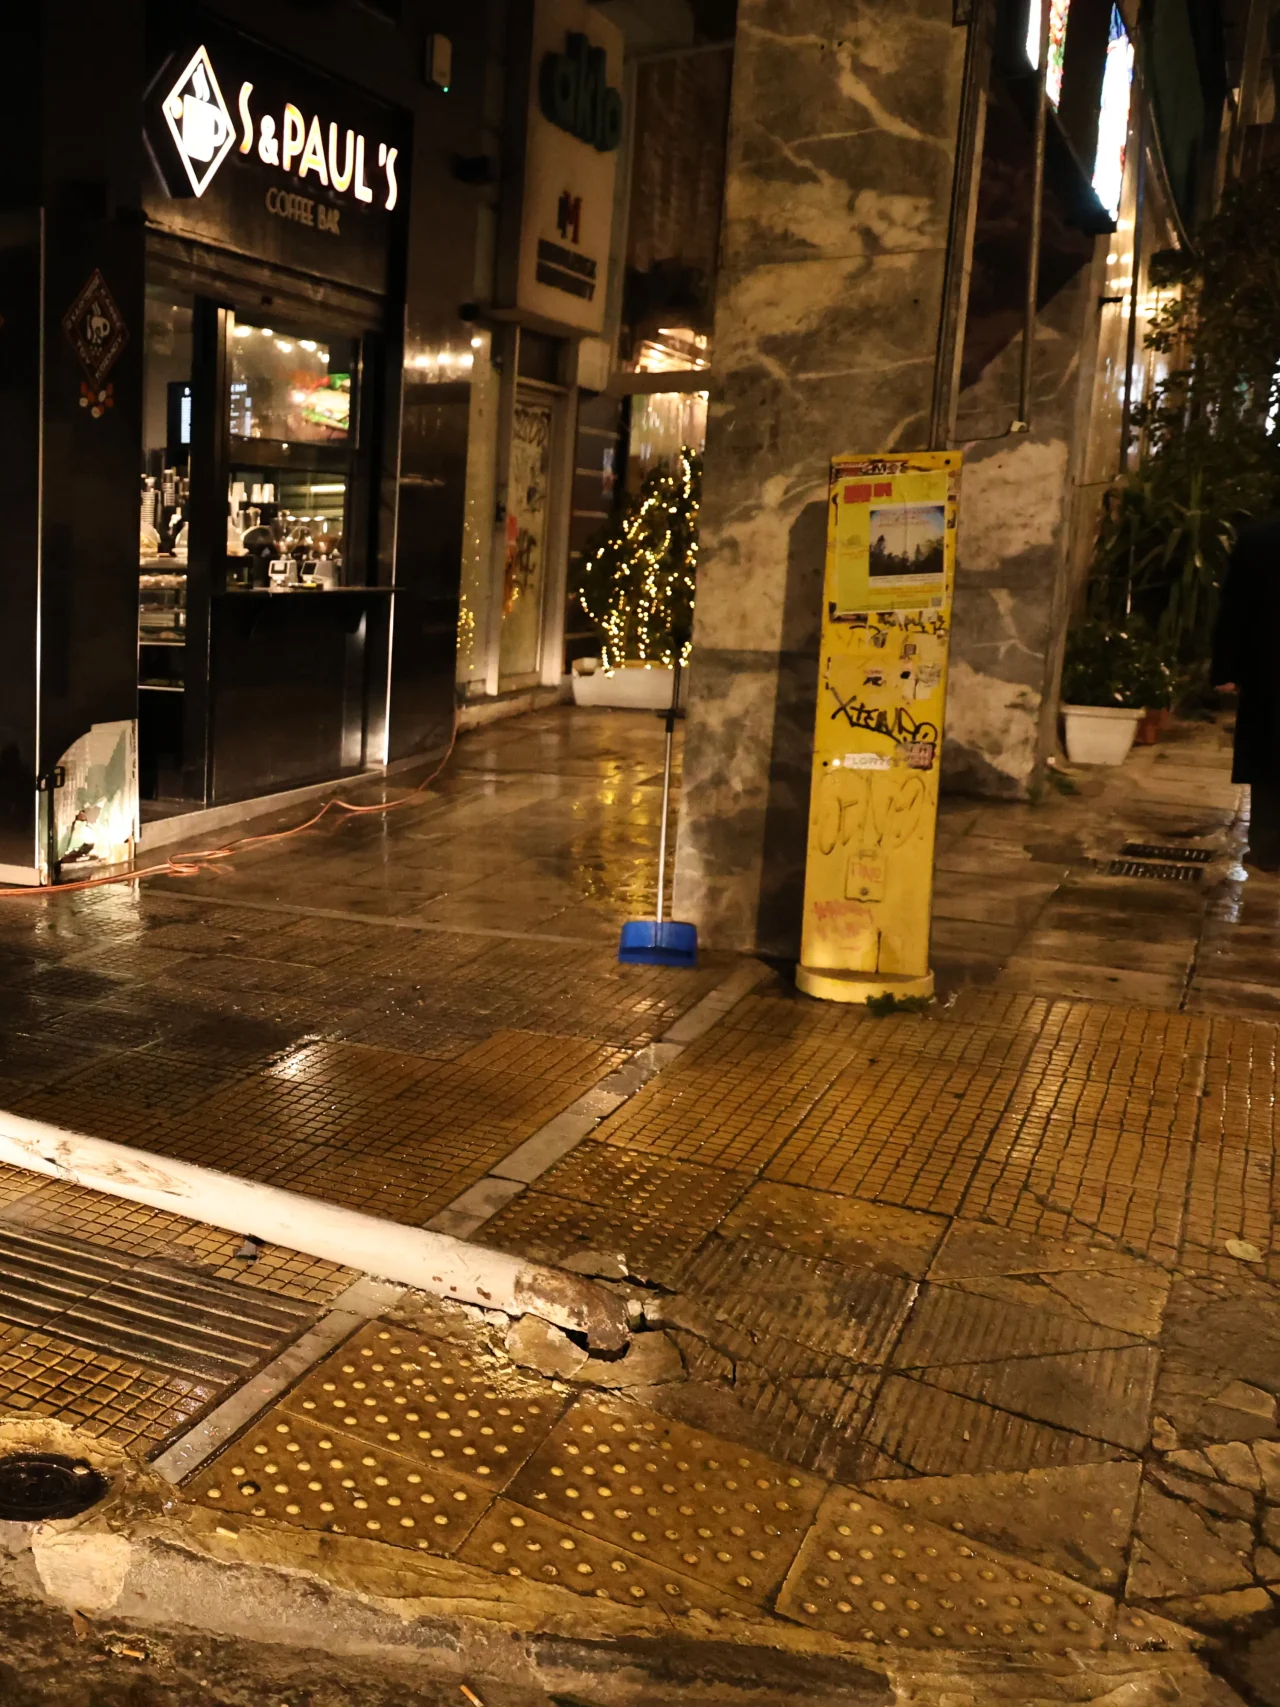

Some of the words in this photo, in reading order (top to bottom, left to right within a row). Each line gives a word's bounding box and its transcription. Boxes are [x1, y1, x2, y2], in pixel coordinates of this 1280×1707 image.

[239, 82, 254, 154] S
[258, 114, 279, 166] &
[265, 186, 314, 227] COFFEE
[318, 203, 341, 236] BAR
